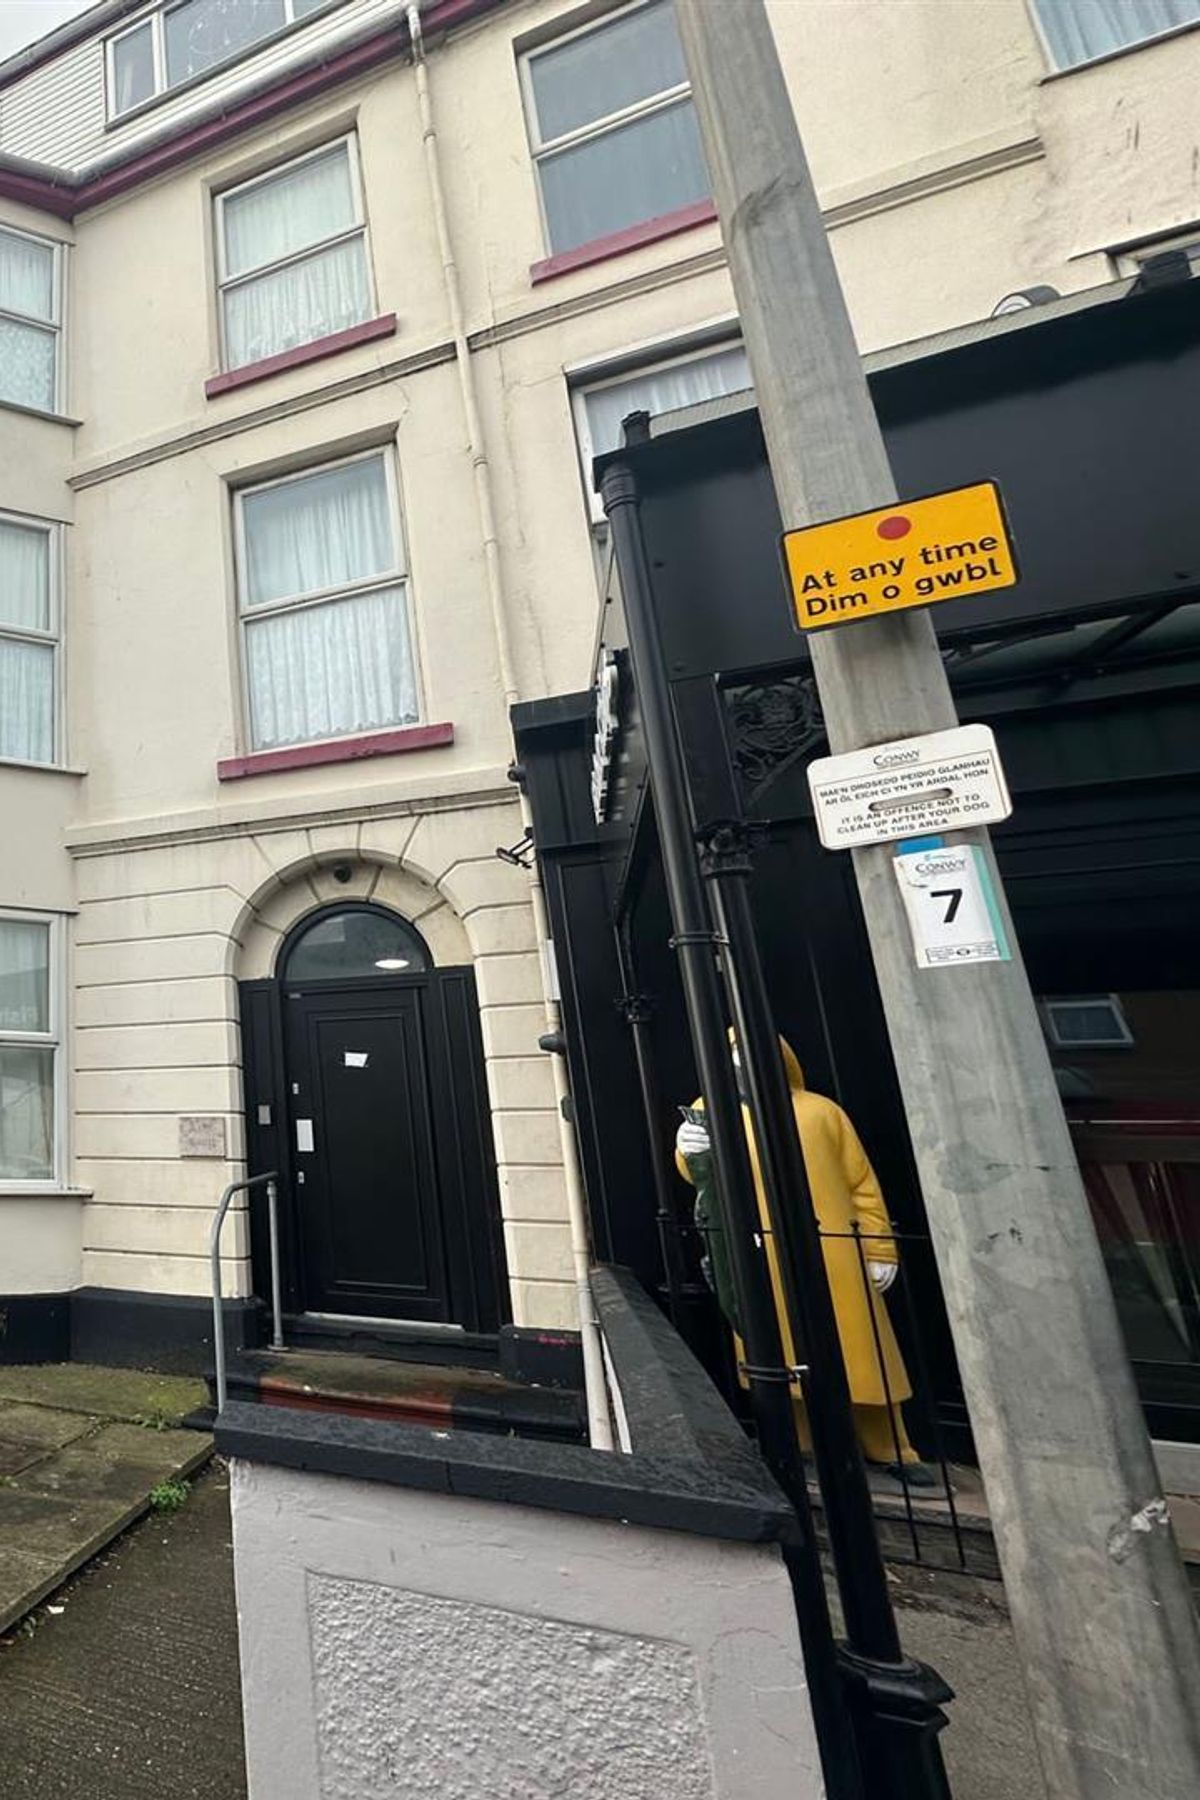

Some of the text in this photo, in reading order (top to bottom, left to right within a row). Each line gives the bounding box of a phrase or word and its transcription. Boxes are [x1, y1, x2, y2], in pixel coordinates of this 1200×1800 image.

[802, 536, 998, 593] At any time
[806, 557, 1002, 616] Dim o gwbl
[837, 802, 990, 834] CLEAN UP AFTER YOUR DOG
[853, 813, 863, 823] IS
[866, 811, 881, 820] AN
[884, 802, 935, 816] OFFENCE
[937, 797, 960, 807] NOT
[964, 793, 981, 802] TO
[891, 822, 916, 833] THIS
[918, 818, 948, 830] AREA
[930, 888, 963, 923] 7
